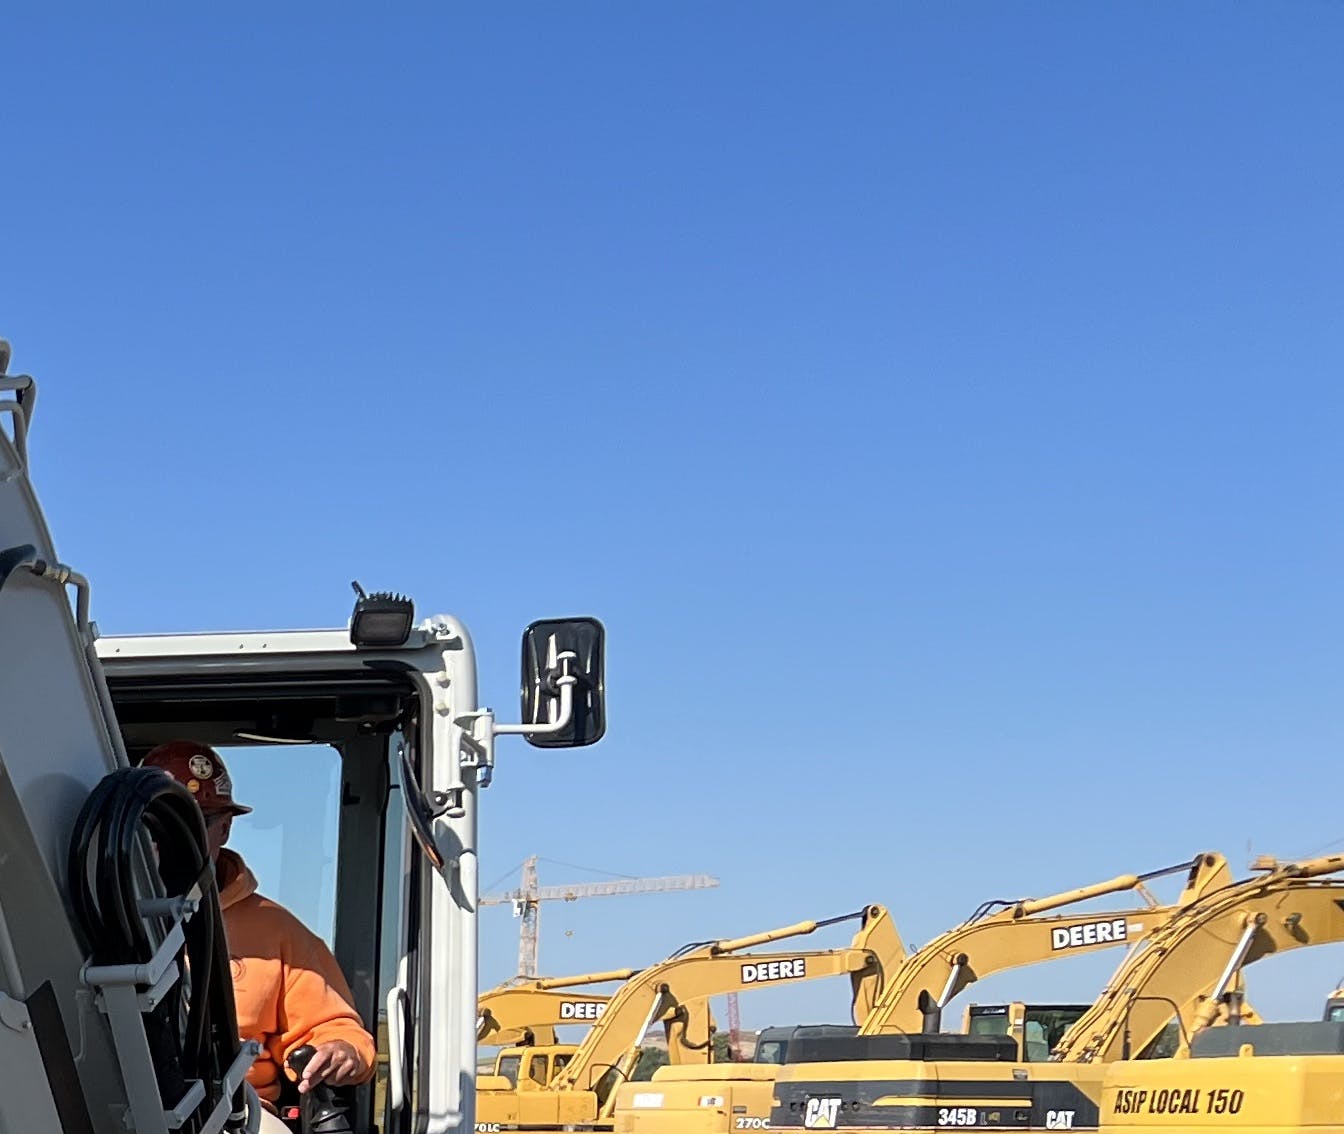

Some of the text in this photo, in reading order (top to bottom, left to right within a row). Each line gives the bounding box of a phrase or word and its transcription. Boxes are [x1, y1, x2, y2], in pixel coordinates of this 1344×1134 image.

[1052, 919, 1126, 949] DEERE
[742, 959, 805, 983] DEERE
[561, 1002, 609, 1019] DEER
[1113, 1089, 1245, 1114] ASIP LOCAL 150
[805, 1098, 842, 1127] CAT
[938, 1108, 977, 1126] 345B
[1046, 1110, 1075, 1129] CAT
[474, 1123, 500, 1132] 70LC
